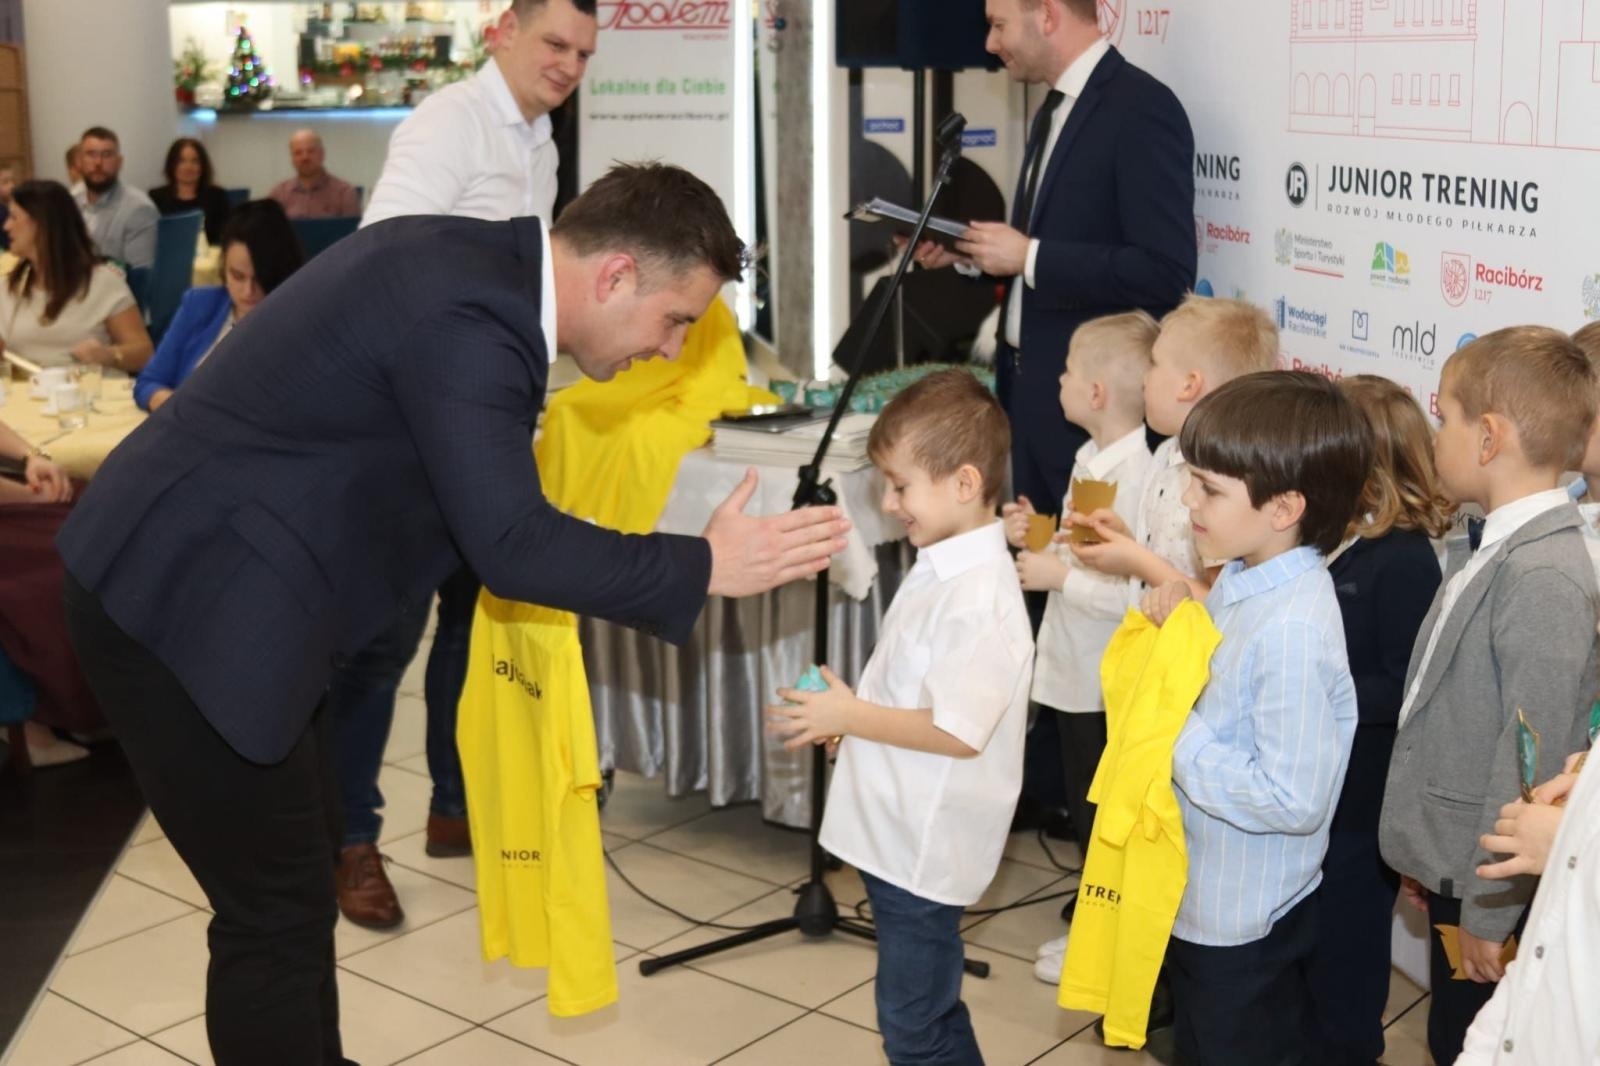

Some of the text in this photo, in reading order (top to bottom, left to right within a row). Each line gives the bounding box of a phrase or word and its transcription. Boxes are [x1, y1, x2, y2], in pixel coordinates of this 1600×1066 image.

[1137, 10, 1171, 44] 1217
[590, 79, 726, 96] Lokalnie dla Ciebie
[1196, 153, 1240, 181] NING
[1328, 165, 1540, 214] JUNIOR TRENING
[1206, 222, 1251, 244] Racibórz
[1327, 204, 1538, 239] ROZWÓJ MŁODEGO PIŁKARZA
[1294, 233, 1333, 250] Ministerstwo
[1475, 263, 1543, 292] Racibórz
[1474, 288, 1493, 304] 1217
[1288, 305, 1327, 328] Wodociągi
[1392, 320, 1436, 356] mld
[1292, 357, 1343, 382] Racibó
[501, 849, 541, 861] NIOR
